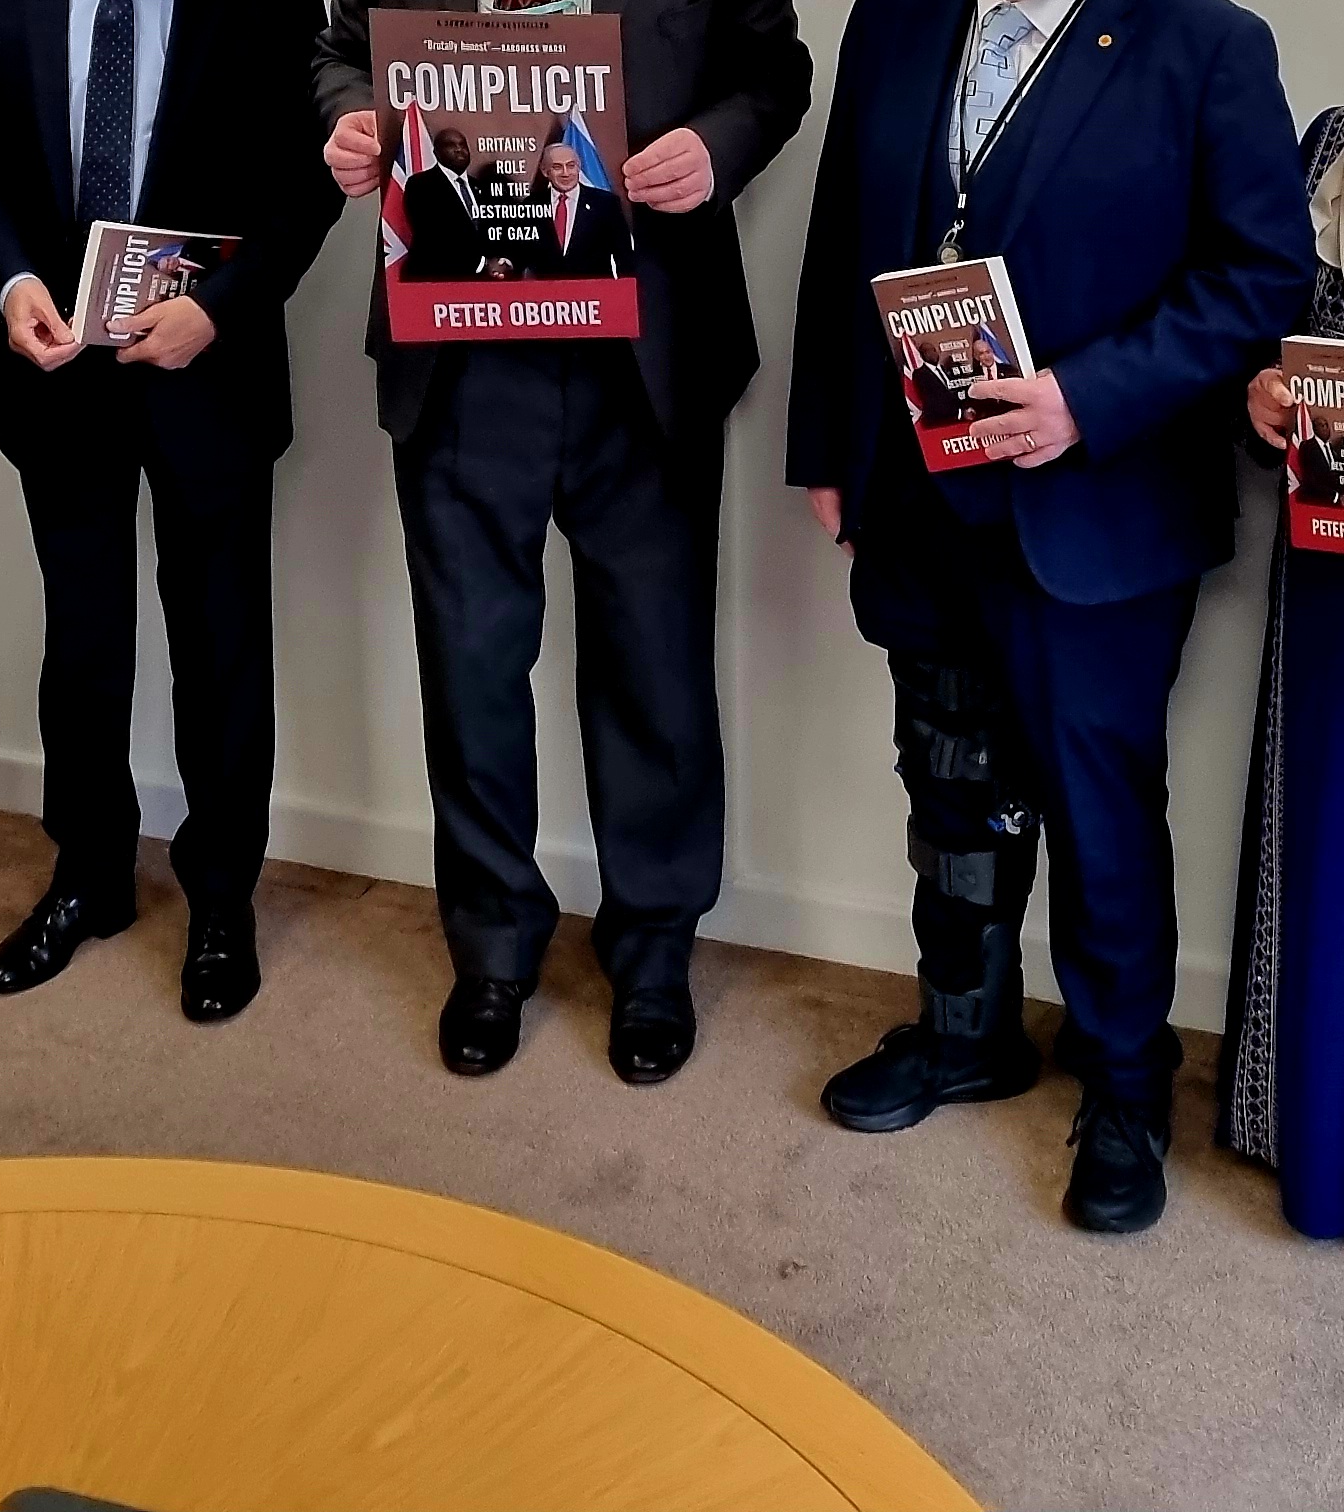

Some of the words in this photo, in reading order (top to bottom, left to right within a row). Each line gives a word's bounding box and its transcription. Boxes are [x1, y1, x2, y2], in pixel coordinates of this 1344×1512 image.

[387, 61, 611, 113] COMPLICIT
[478, 137, 537, 153] BRITAIN'S
[496, 160, 526, 175] ROLE
[490, 182, 503, 197] IN
[506, 182, 530, 197] THE
[472, 204, 552, 220] DESTRUCTION
[488, 227, 503, 241] OF
[507, 226, 540, 240] GAZA
[433, 303, 504, 328] PETER
[509, 300, 602, 326] OBORNE
[887, 294, 998, 338] COMPLICIT
[942, 435, 980, 455] PETER
